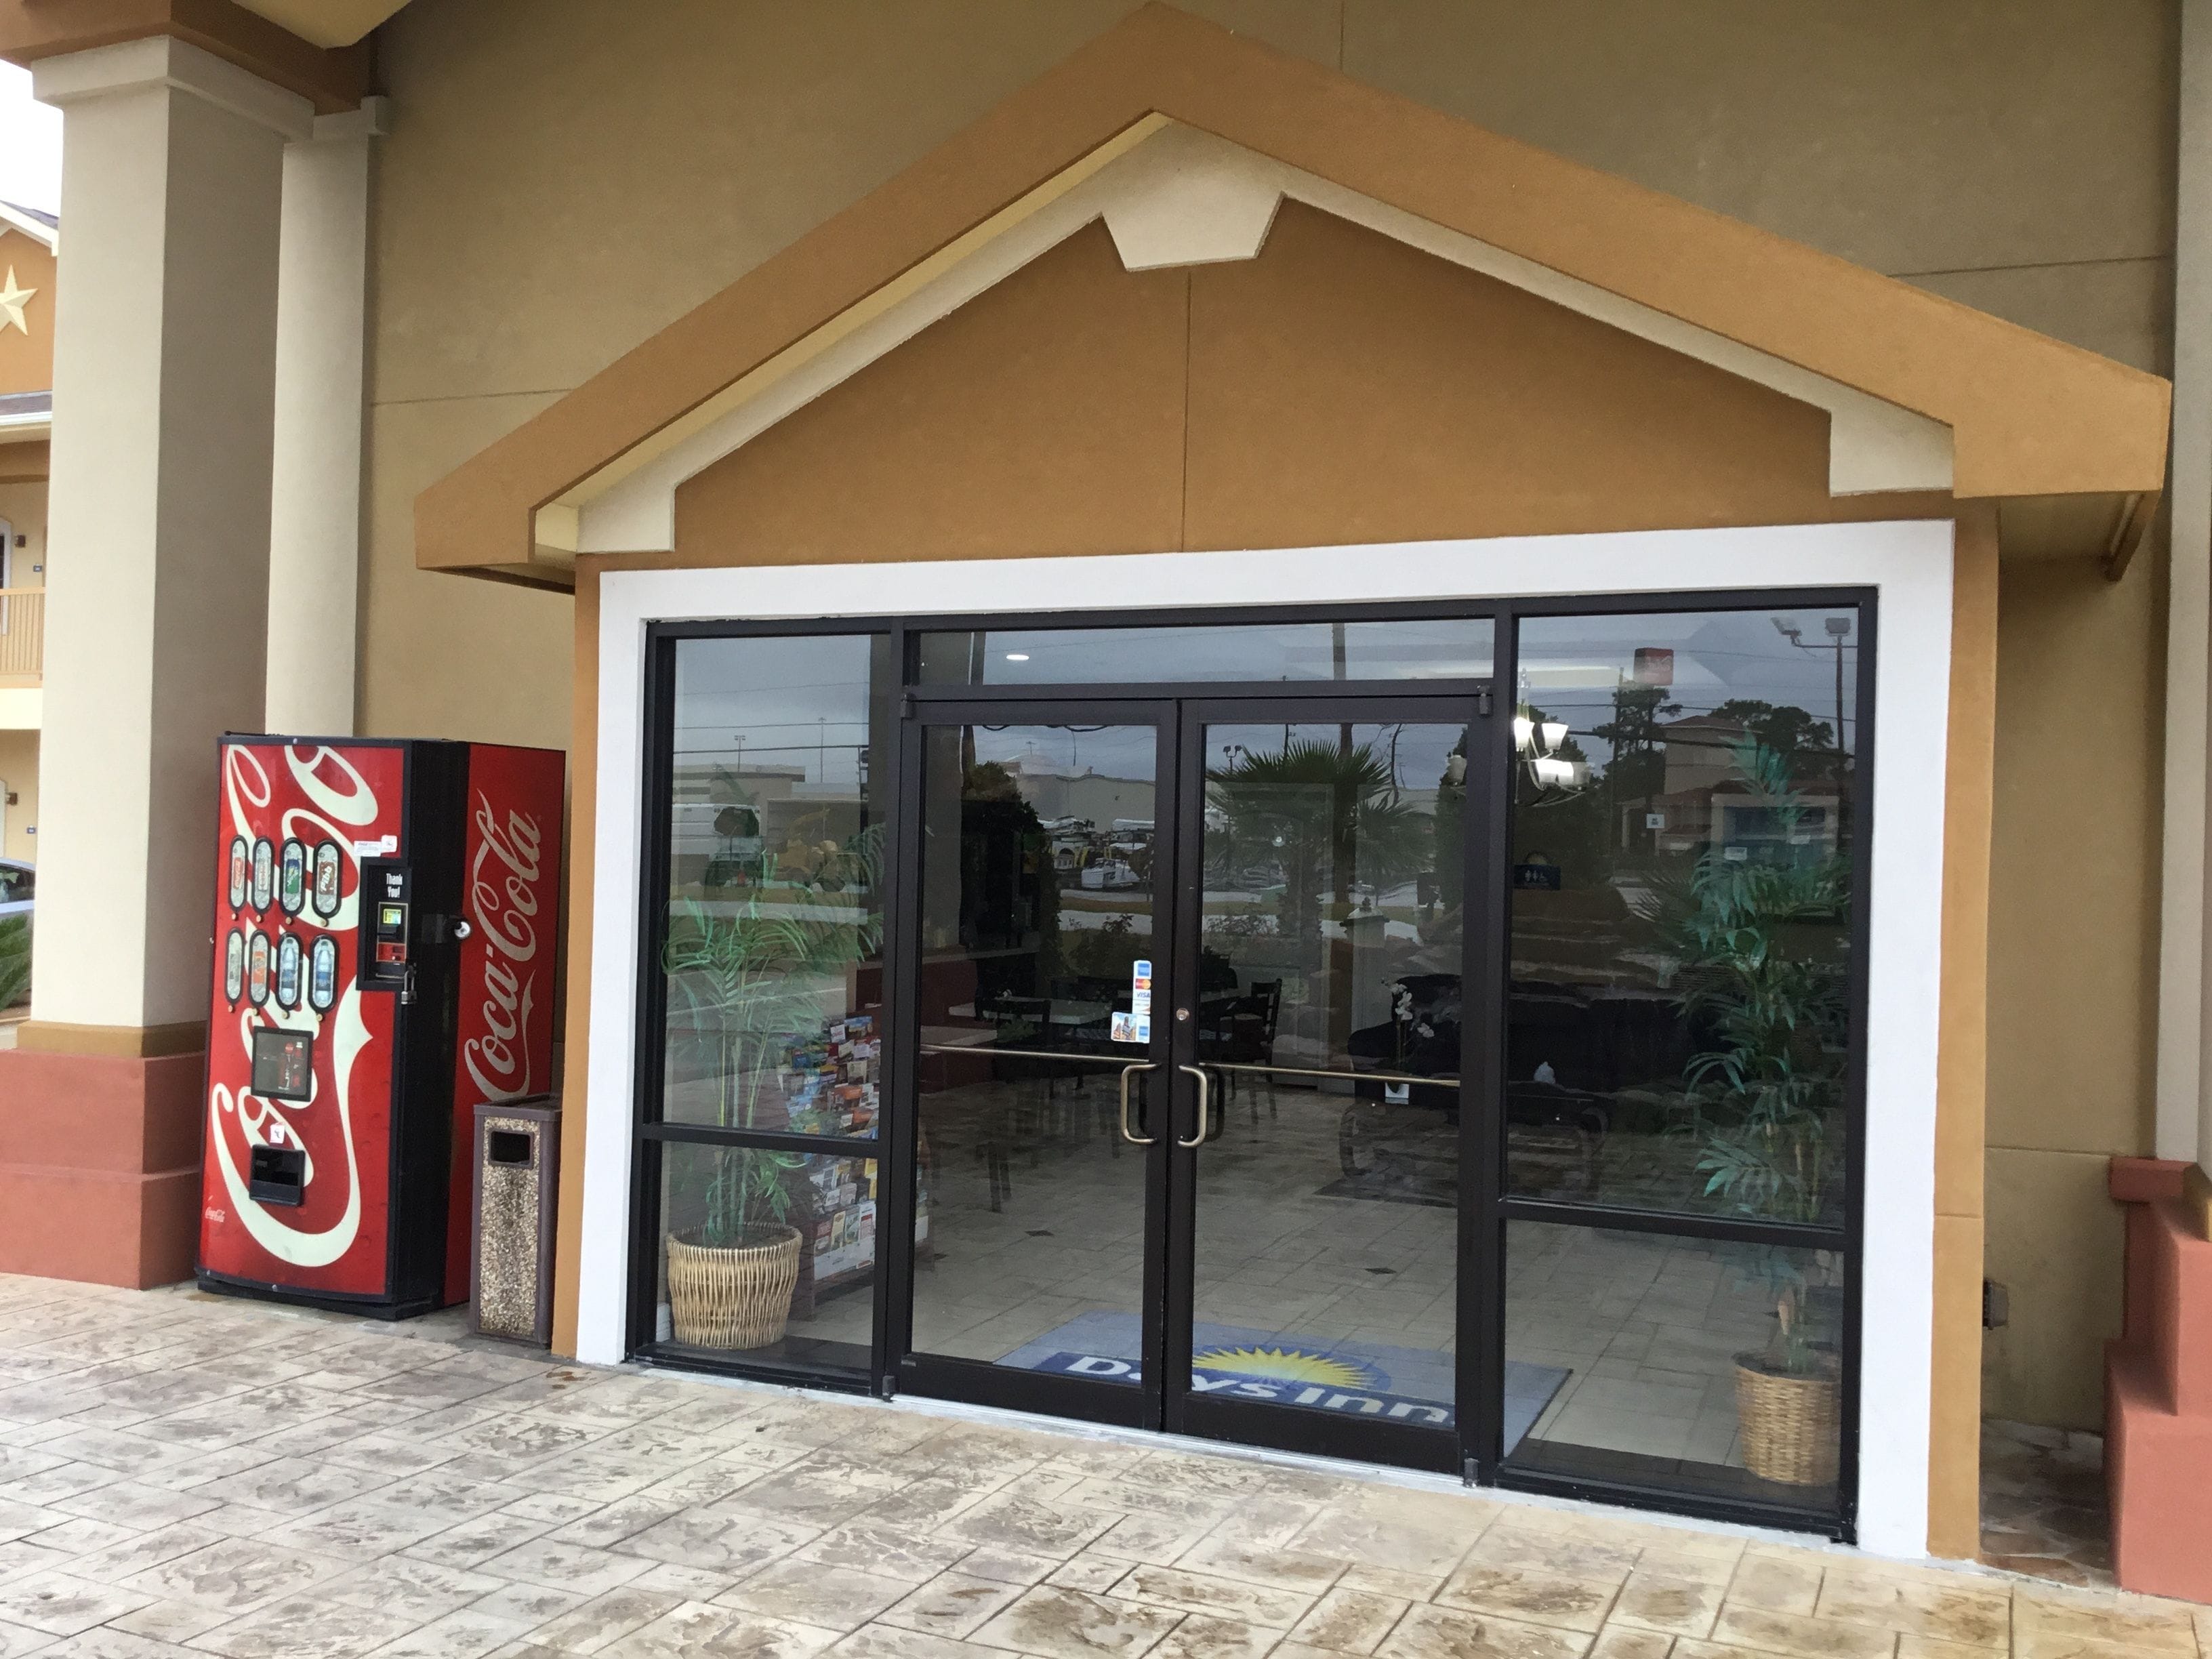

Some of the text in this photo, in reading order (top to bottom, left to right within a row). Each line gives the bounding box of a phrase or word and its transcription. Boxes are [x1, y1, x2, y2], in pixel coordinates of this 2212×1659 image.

[320, 865, 333, 892] Pibb
[386, 873, 403, 885] Thank
[388, 886, 401, 898] You!
[465, 788, 541, 1102] Coca-Cola
[1065, 1356, 1451, 1423] Dys Inn
